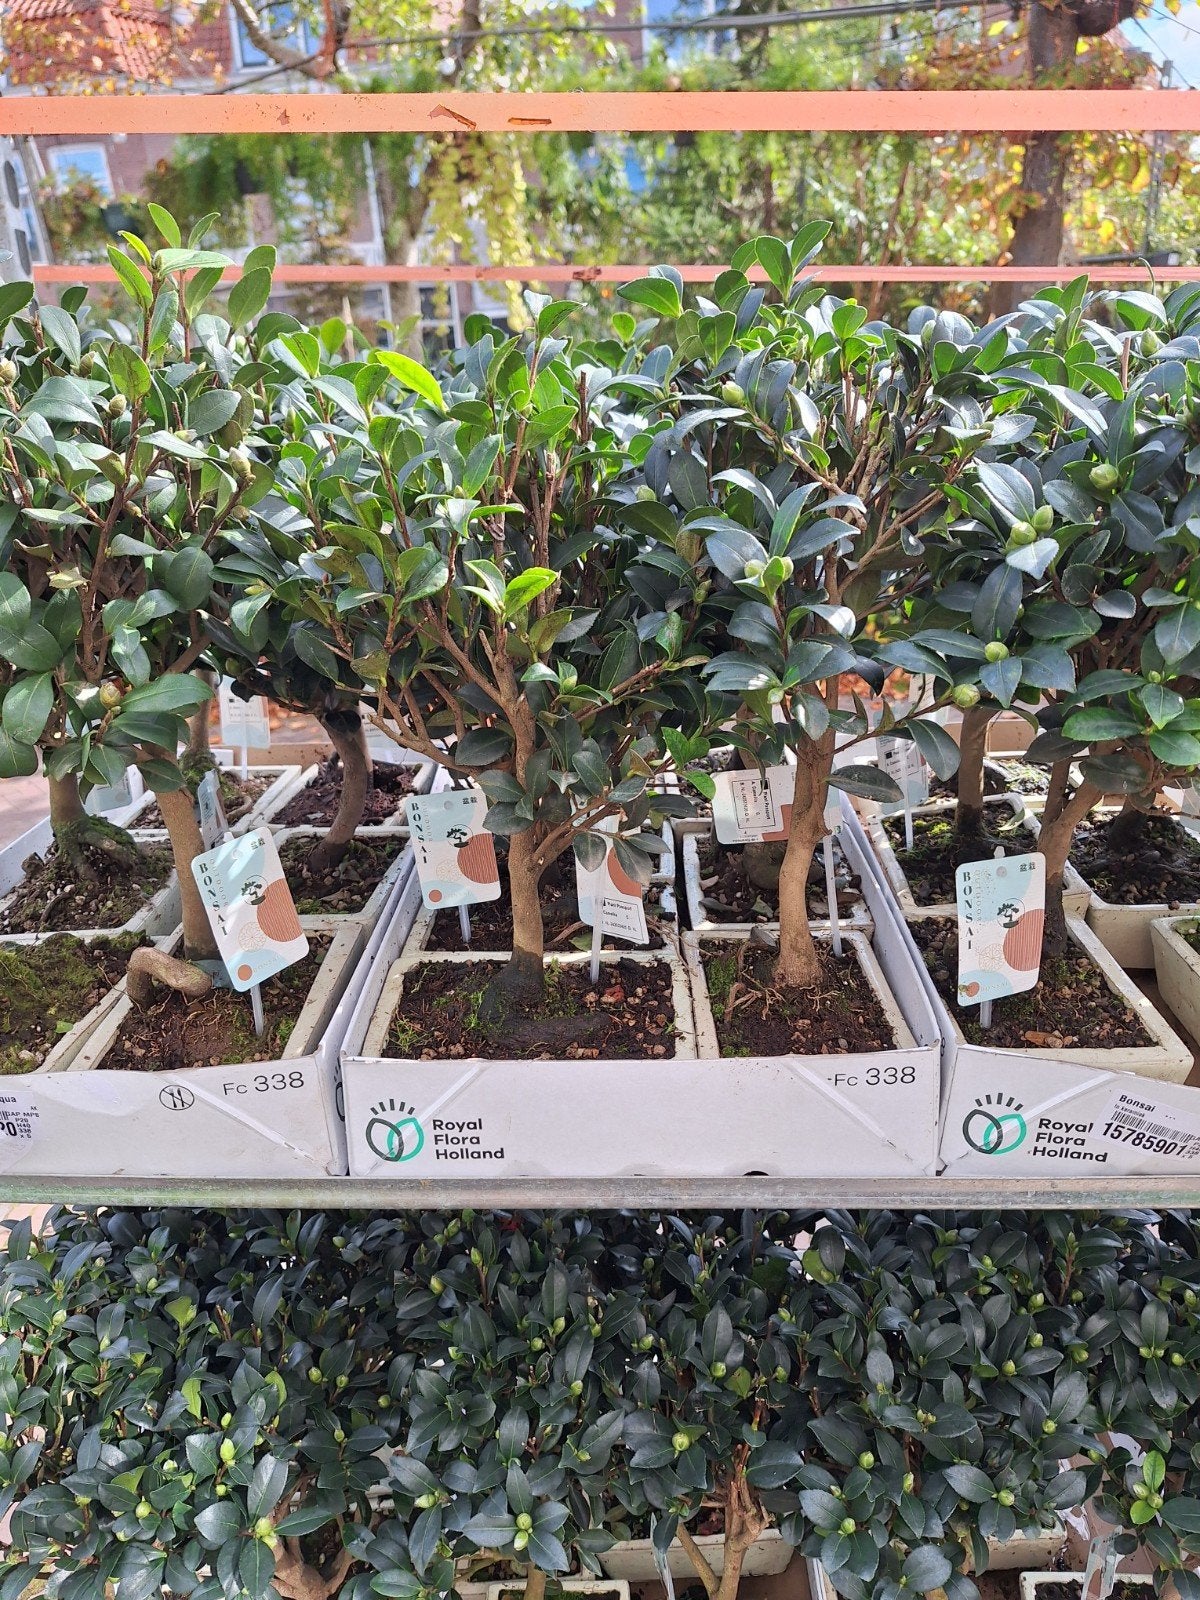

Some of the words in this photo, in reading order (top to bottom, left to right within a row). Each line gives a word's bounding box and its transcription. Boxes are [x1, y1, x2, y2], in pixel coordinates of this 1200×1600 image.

[411, 802, 428, 864] BONSAI
[198, 862, 228, 936] BONSAI
[962, 871, 974, 950] BONSAI
[253, 1071, 305, 1093] 338
[865, 1066, 916, 1086] 338
[1118, 1094, 1157, 1113] Bonsai
[432, 1117, 483, 1133] Royal
[1038, 1117, 1094, 1134] Royal
[433, 1133, 481, 1146] Flora
[1035, 1132, 1086, 1147] Flora
[1102, 1122, 1188, 1156] 15785901
[435, 1147, 505, 1160] Holland
[1032, 1145, 1109, 1163] Holland
